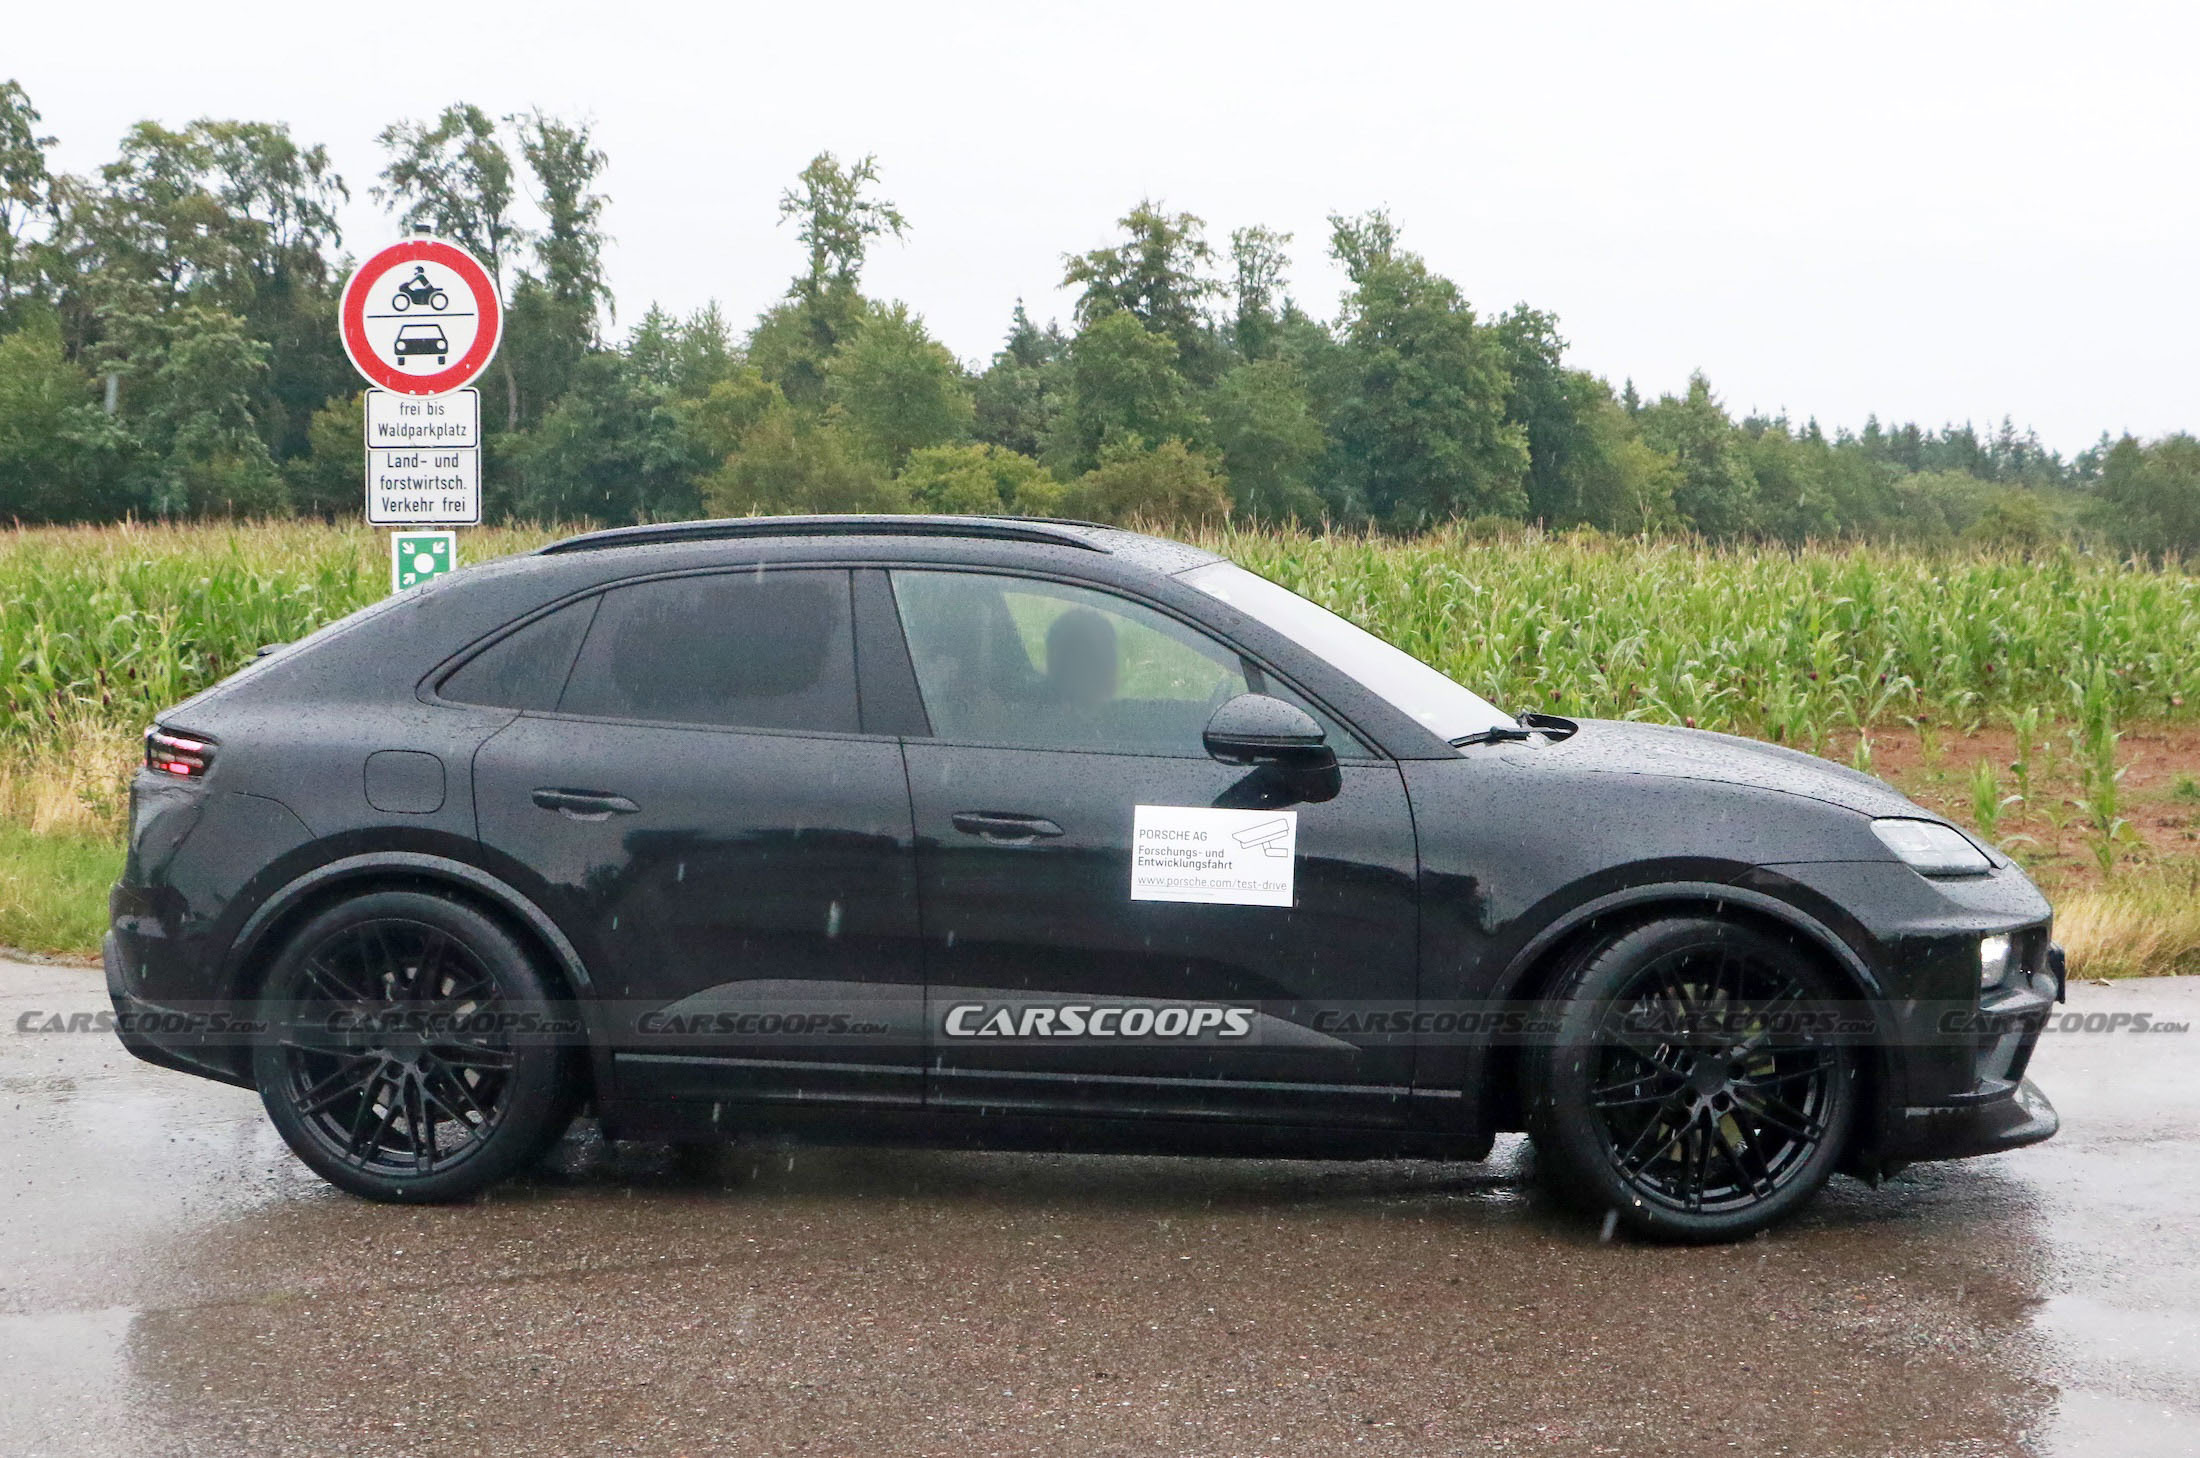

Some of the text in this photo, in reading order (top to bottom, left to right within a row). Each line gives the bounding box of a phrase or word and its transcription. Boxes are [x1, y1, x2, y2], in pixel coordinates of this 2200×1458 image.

[400, 402, 445, 416] frei bis
[378, 423, 467, 440] Waldparkplatz
[387, 453, 459, 468] Land- und
[380, 475, 467, 491] forstwirtsch.
[382, 497, 466, 513] Verkehr frei
[1139, 829, 1208, 841] PORSCHE AG
[1138, 845, 1224, 859] Forschungs- und
[1138, 856, 1233, 870] Entwicklungsfahrt
[1137, 876, 1287, 890] www.porsche.com/test-drive
